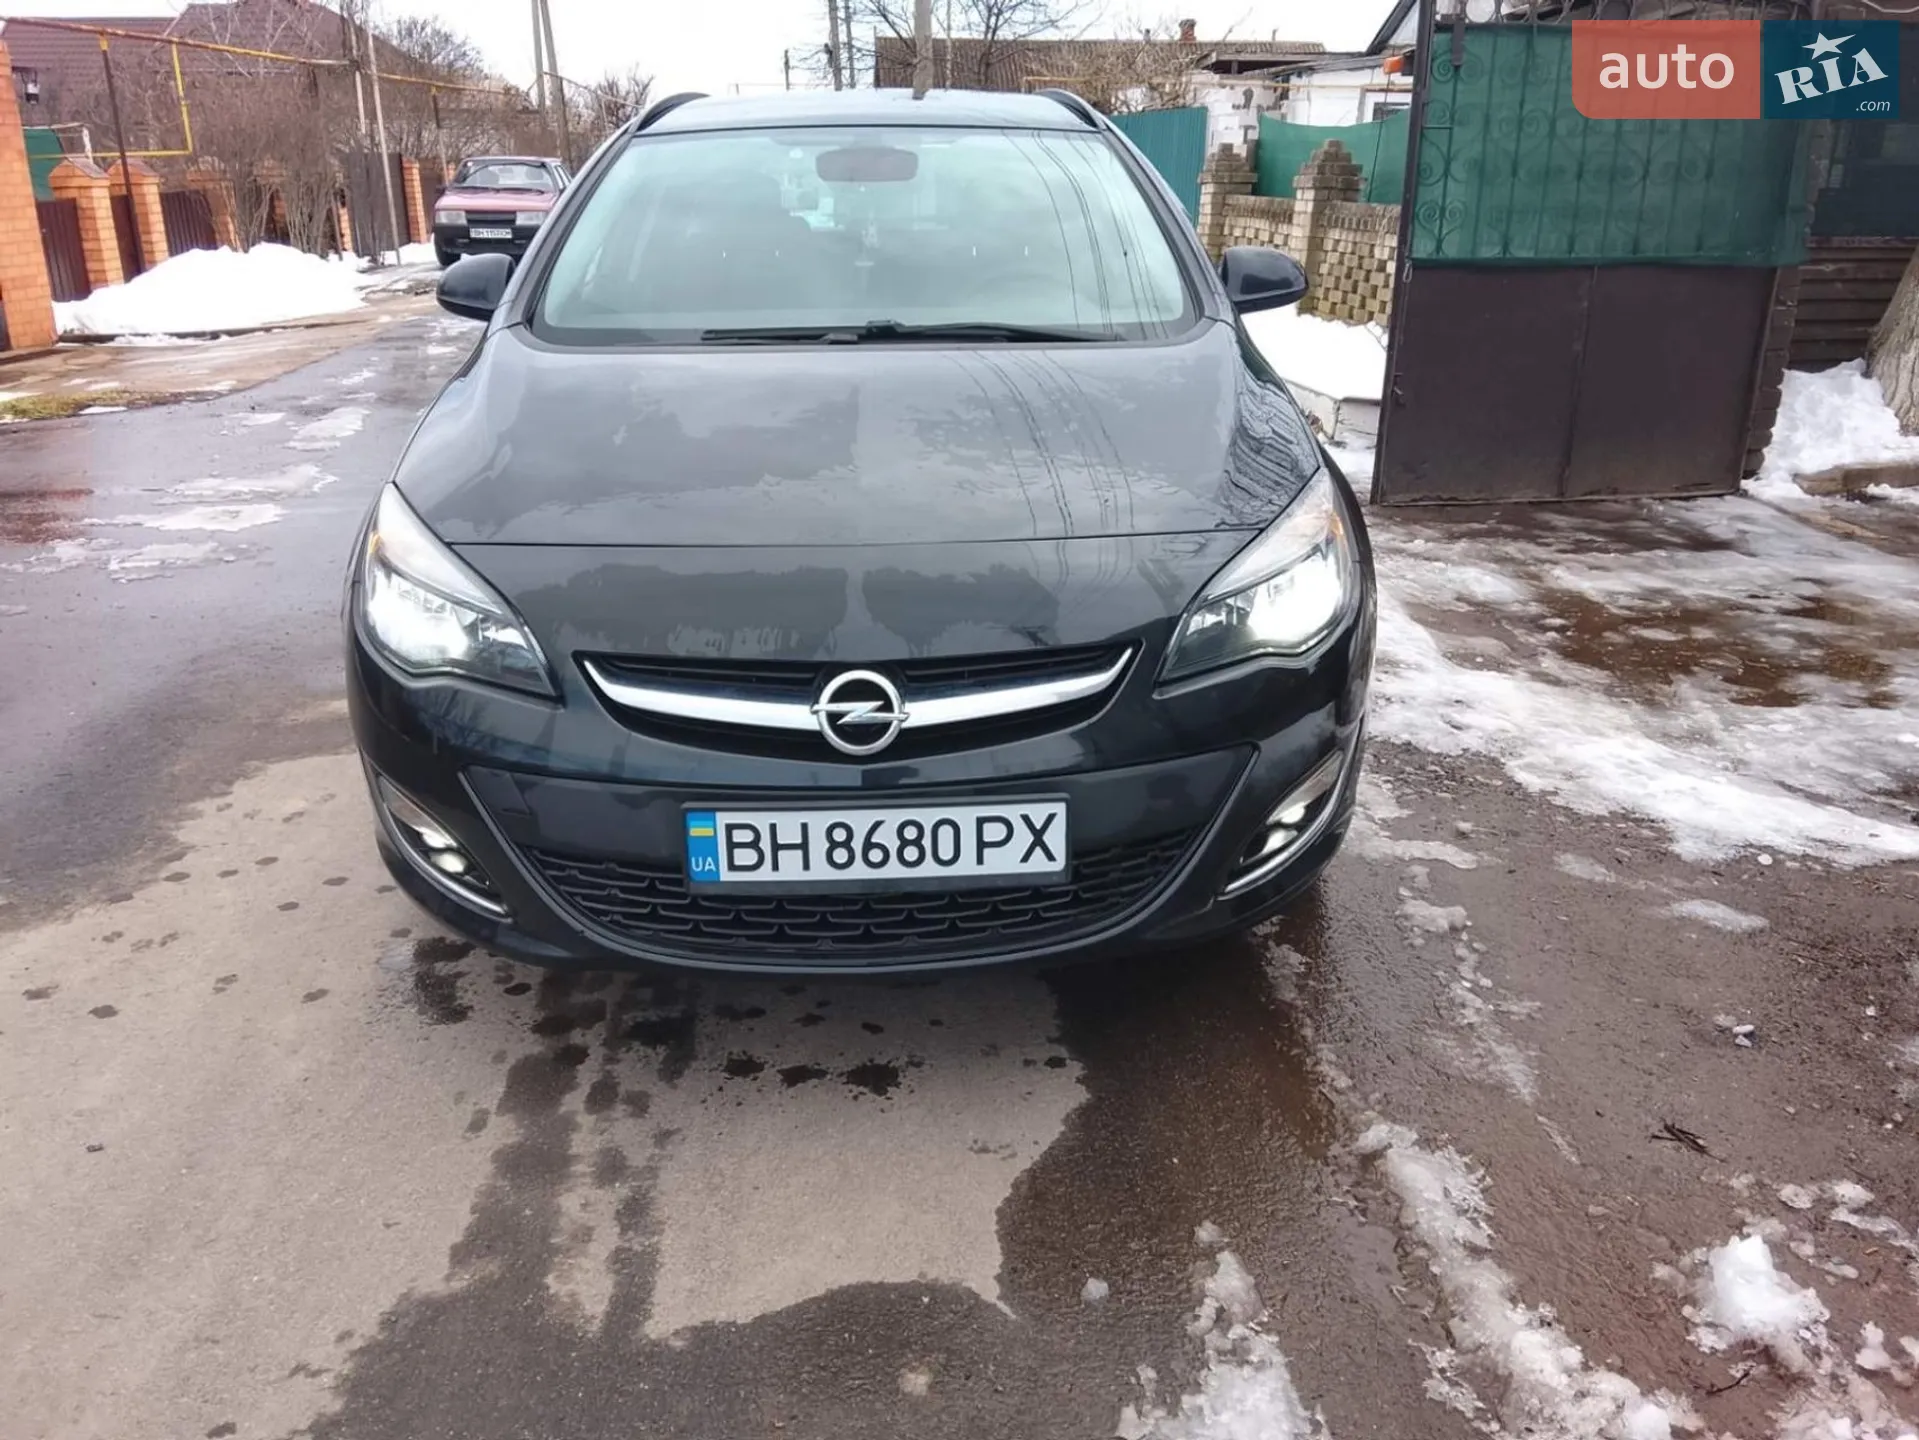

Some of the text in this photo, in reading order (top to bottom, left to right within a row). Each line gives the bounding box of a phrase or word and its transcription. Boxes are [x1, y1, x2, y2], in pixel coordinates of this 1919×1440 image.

[724, 811, 1058, 872] BH 8680 PX
[691, 856, 716, 872] UA
